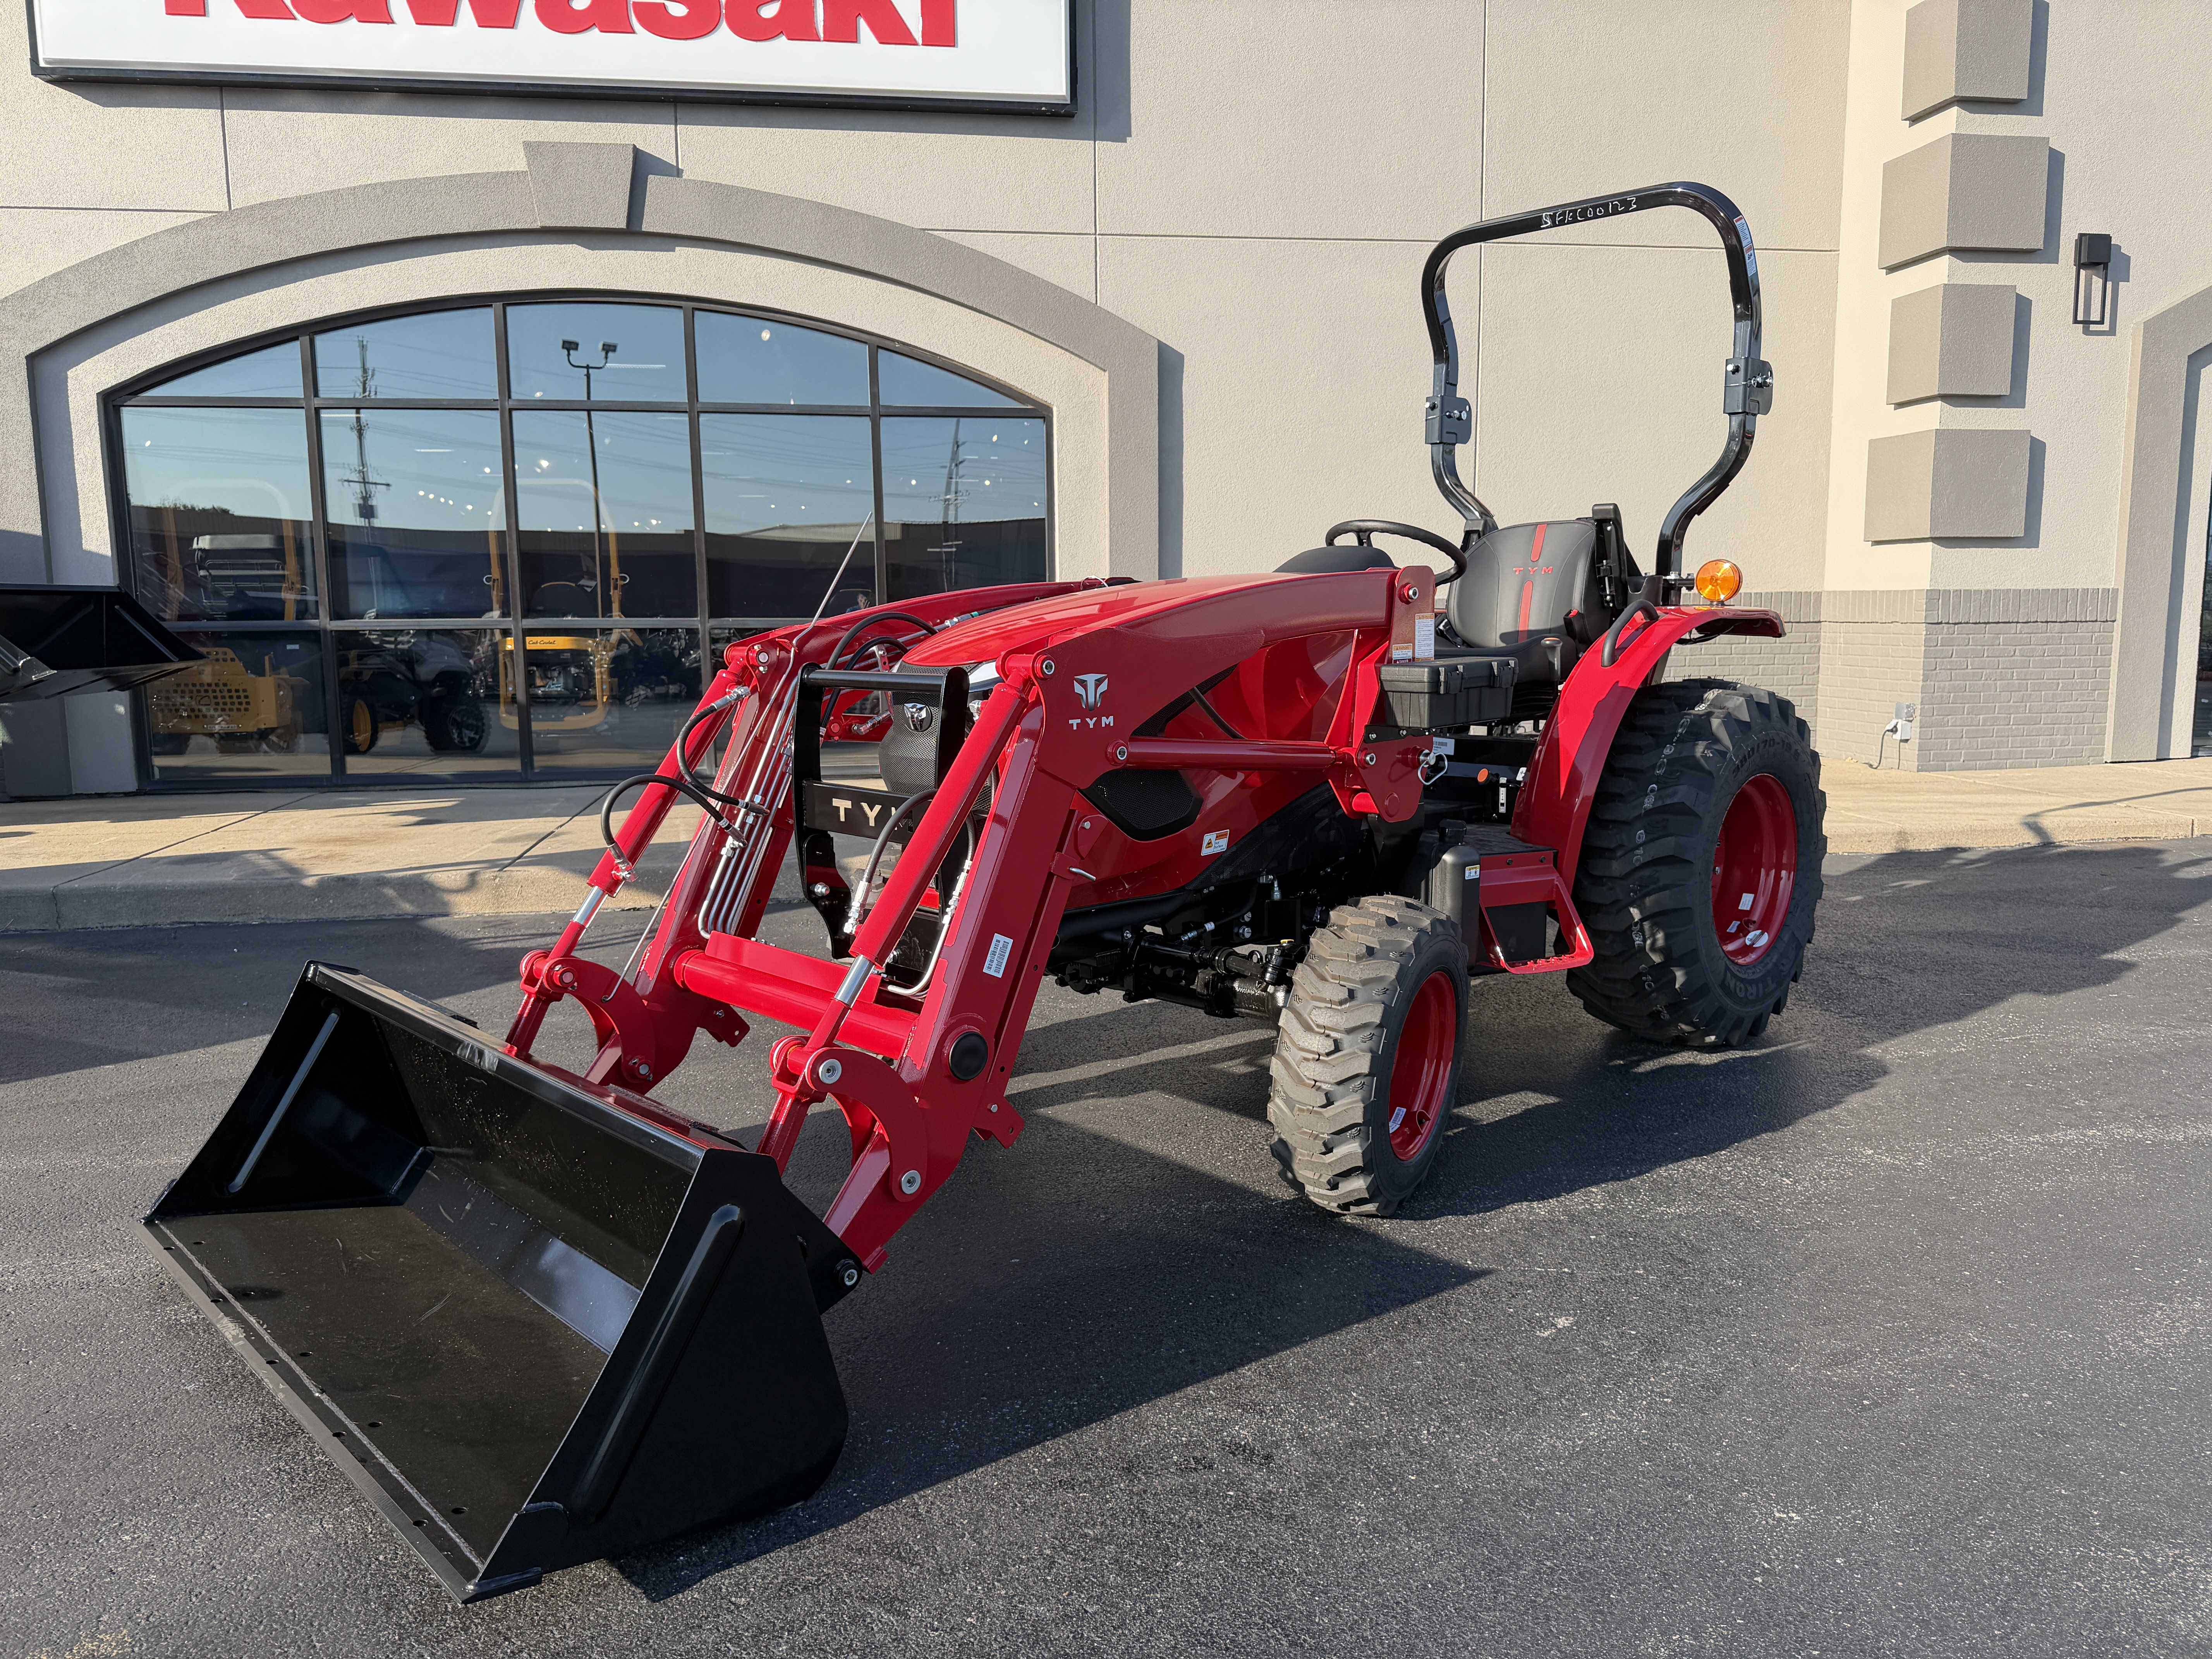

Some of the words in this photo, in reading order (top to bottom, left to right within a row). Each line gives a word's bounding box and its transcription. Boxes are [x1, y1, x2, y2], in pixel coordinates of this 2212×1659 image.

[1513, 566, 1553, 575] TYM
[1069, 716, 1114, 730] TYM
[1725, 970, 1777, 1000] TIRON
